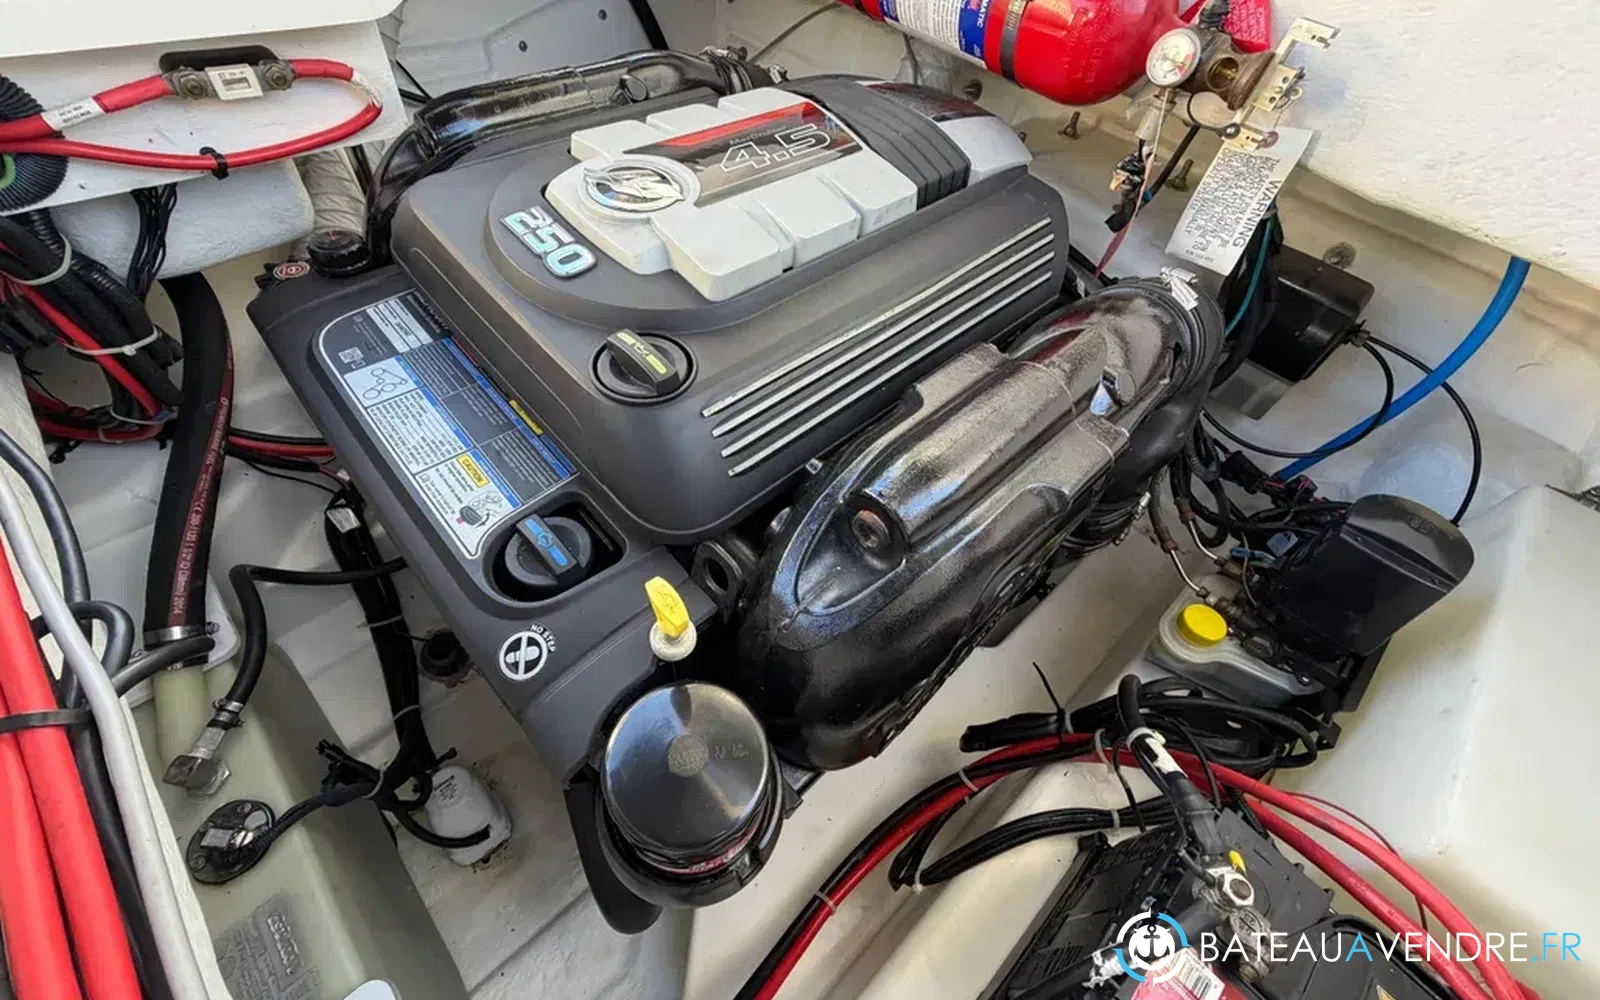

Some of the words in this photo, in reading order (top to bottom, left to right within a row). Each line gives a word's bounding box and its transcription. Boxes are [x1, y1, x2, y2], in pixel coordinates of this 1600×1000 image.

[720, 123, 831, 172] 4.5
[1231, 178, 1282, 248] WARNING
[500, 206, 597, 279] 250
[461, 458, 484, 483] CAUTION
[530, 624, 544, 633] NO
[542, 631, 557, 652] STEP
